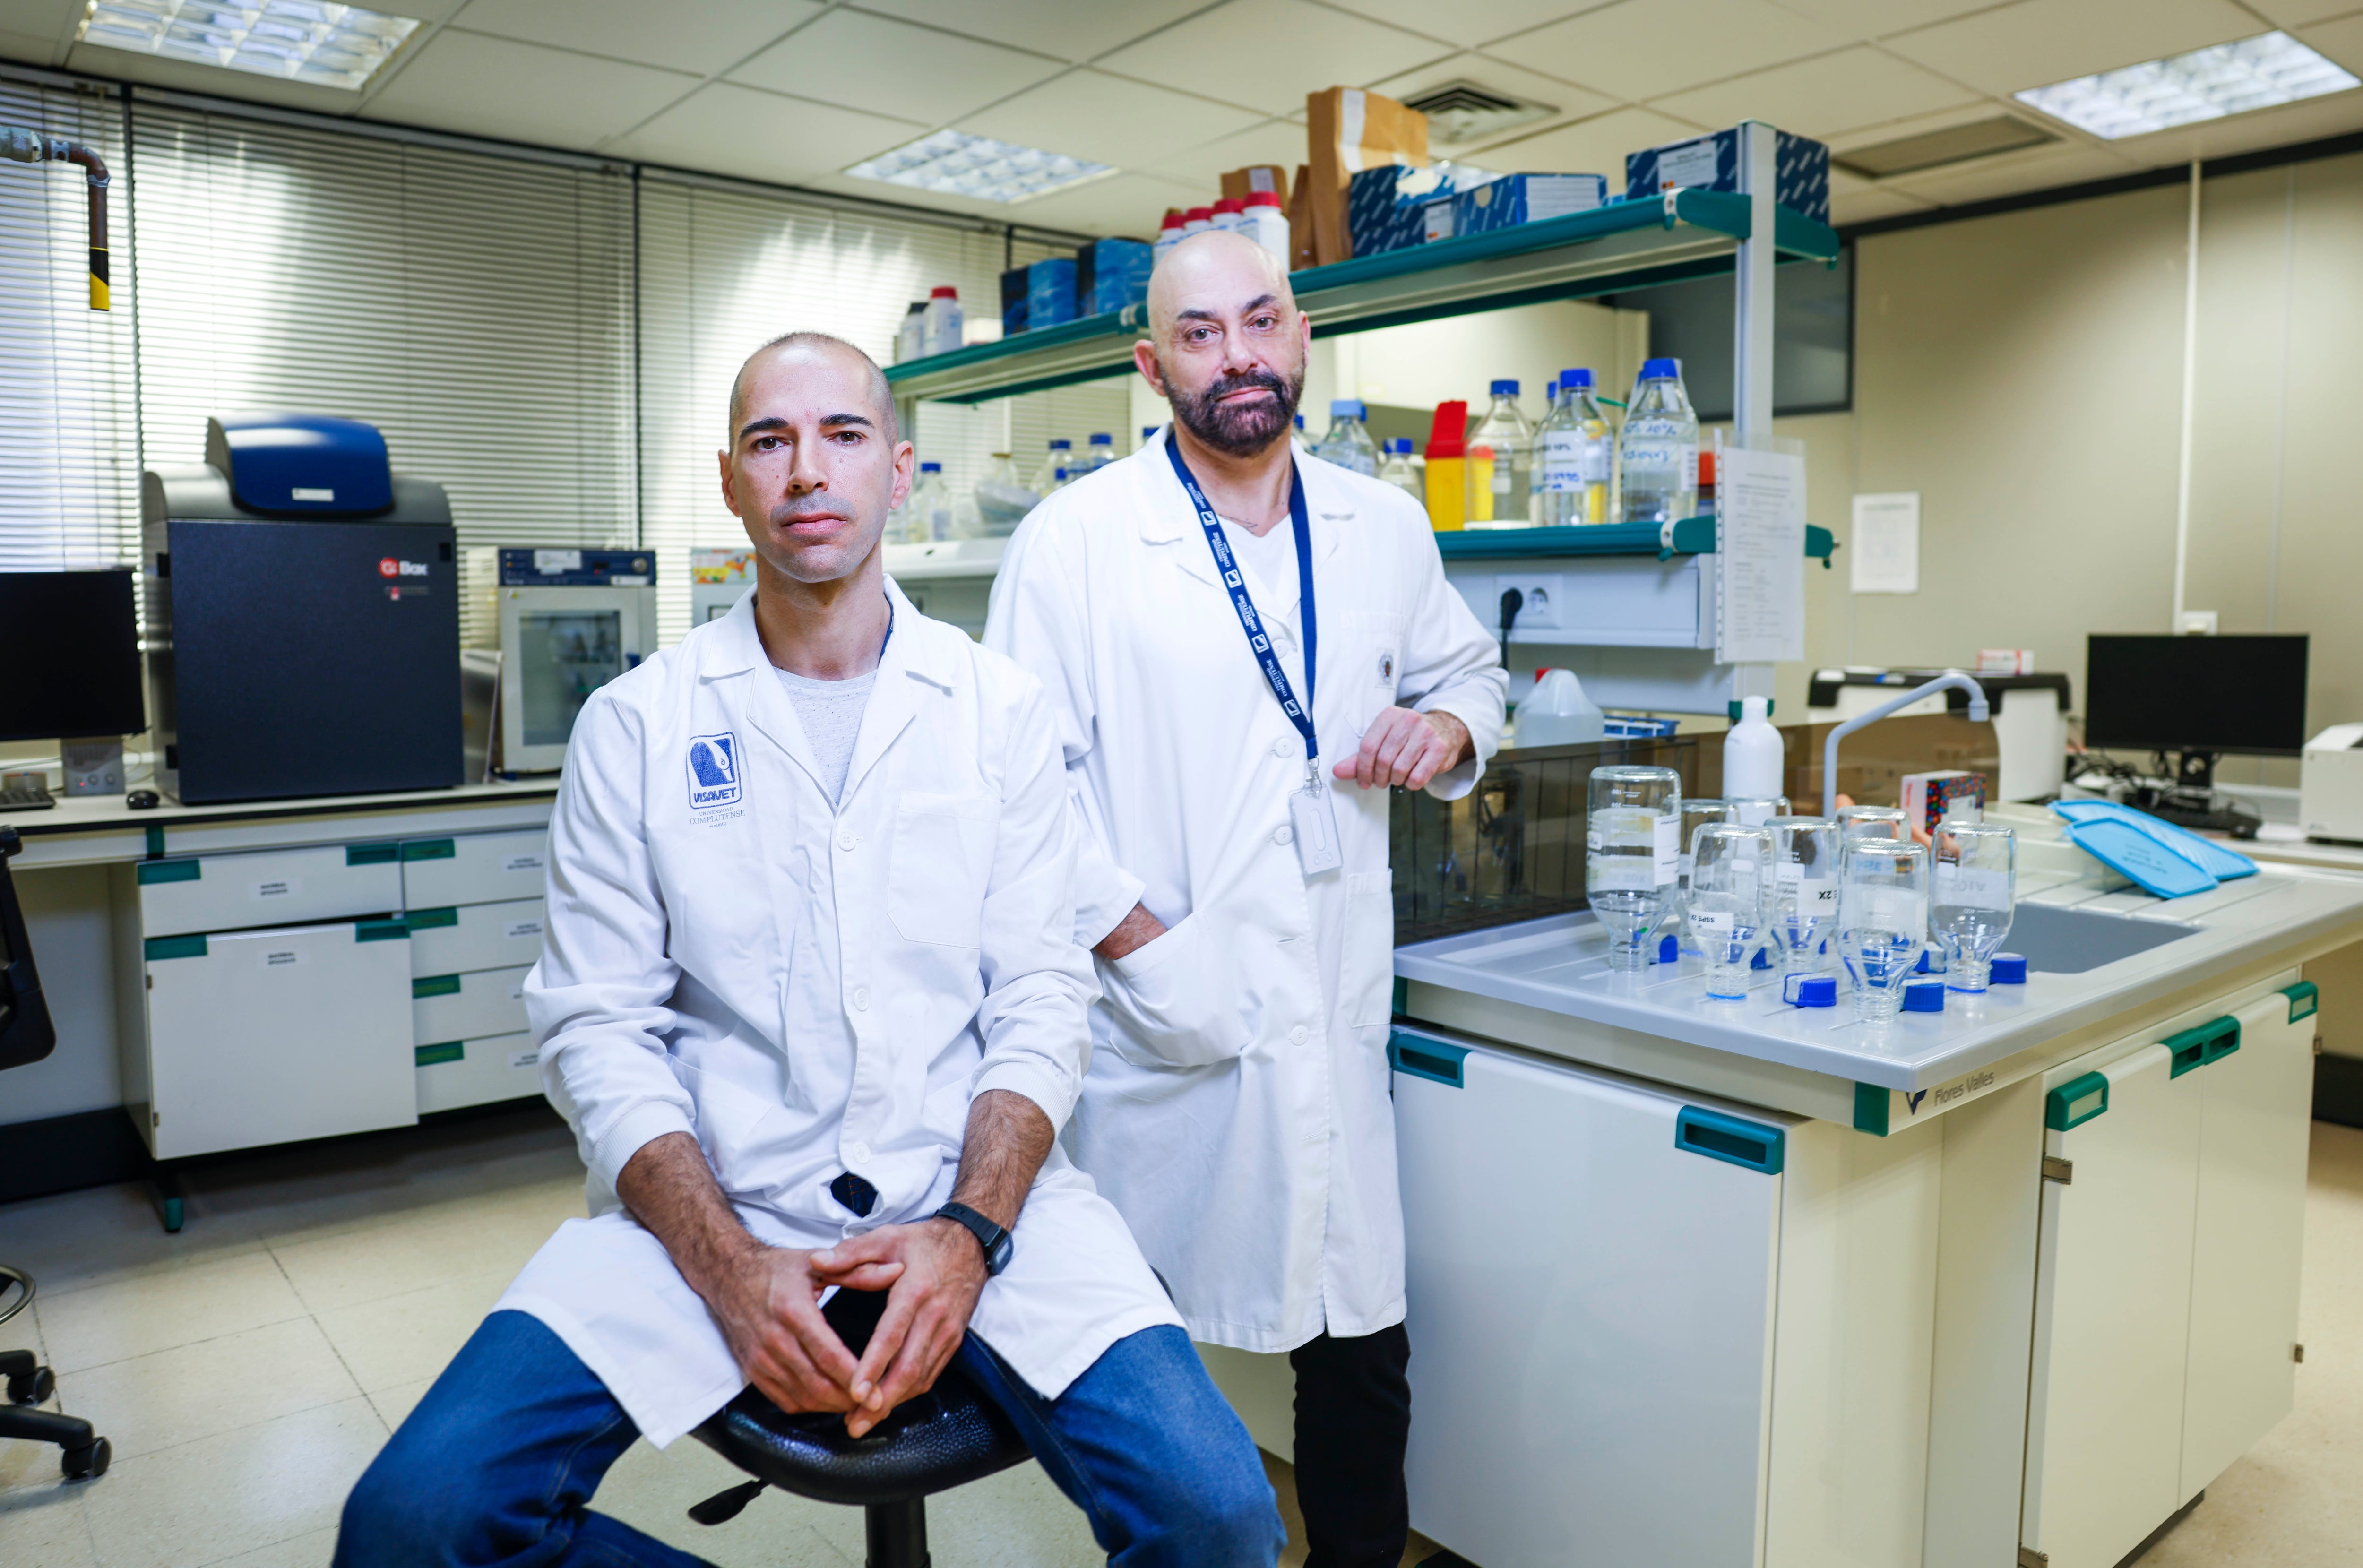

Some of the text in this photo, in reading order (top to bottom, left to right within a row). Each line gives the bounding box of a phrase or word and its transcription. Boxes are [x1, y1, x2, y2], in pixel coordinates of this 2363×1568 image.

[1213, 531, 1231, 567] COMPLUTENSE
[1237, 594, 1258, 632] COMPLUTENSE
[1266, 658, 1288, 697] COMPLUTENSE
[693, 787, 736, 803] VISAVET
[699, 806, 733, 816] UNIVERSIDAD
[690, 810, 745, 825] COMPLUTENSE
[1934, 1071, 1995, 1107] Flores Valles
